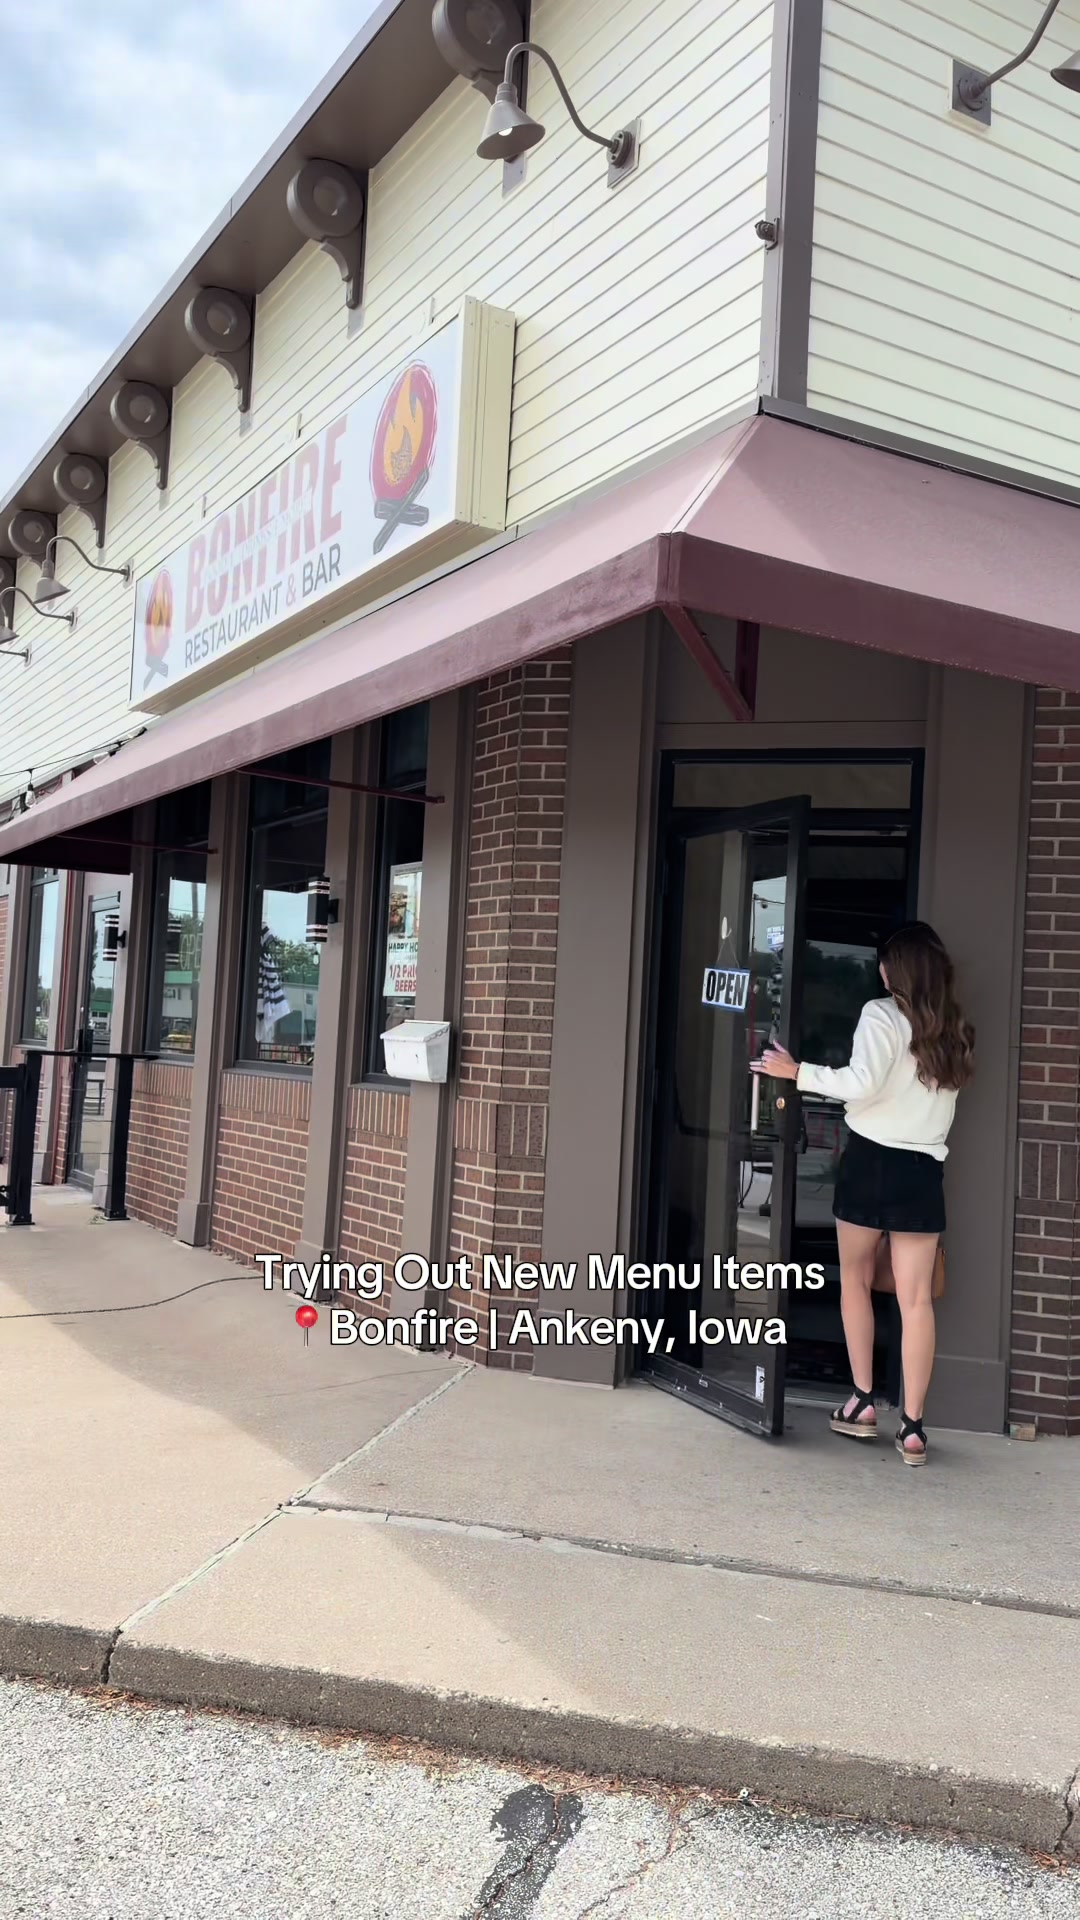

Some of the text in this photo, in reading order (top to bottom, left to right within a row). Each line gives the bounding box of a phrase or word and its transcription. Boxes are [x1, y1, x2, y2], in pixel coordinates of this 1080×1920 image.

[184, 413, 348, 633] BONFIRE
[184, 543, 341, 668] RESTAURANT & BAR
[388, 942, 408, 952] HAPPY
[390, 964, 417, 980] 1/2 PRI
[706, 971, 746, 1006] OPEN
